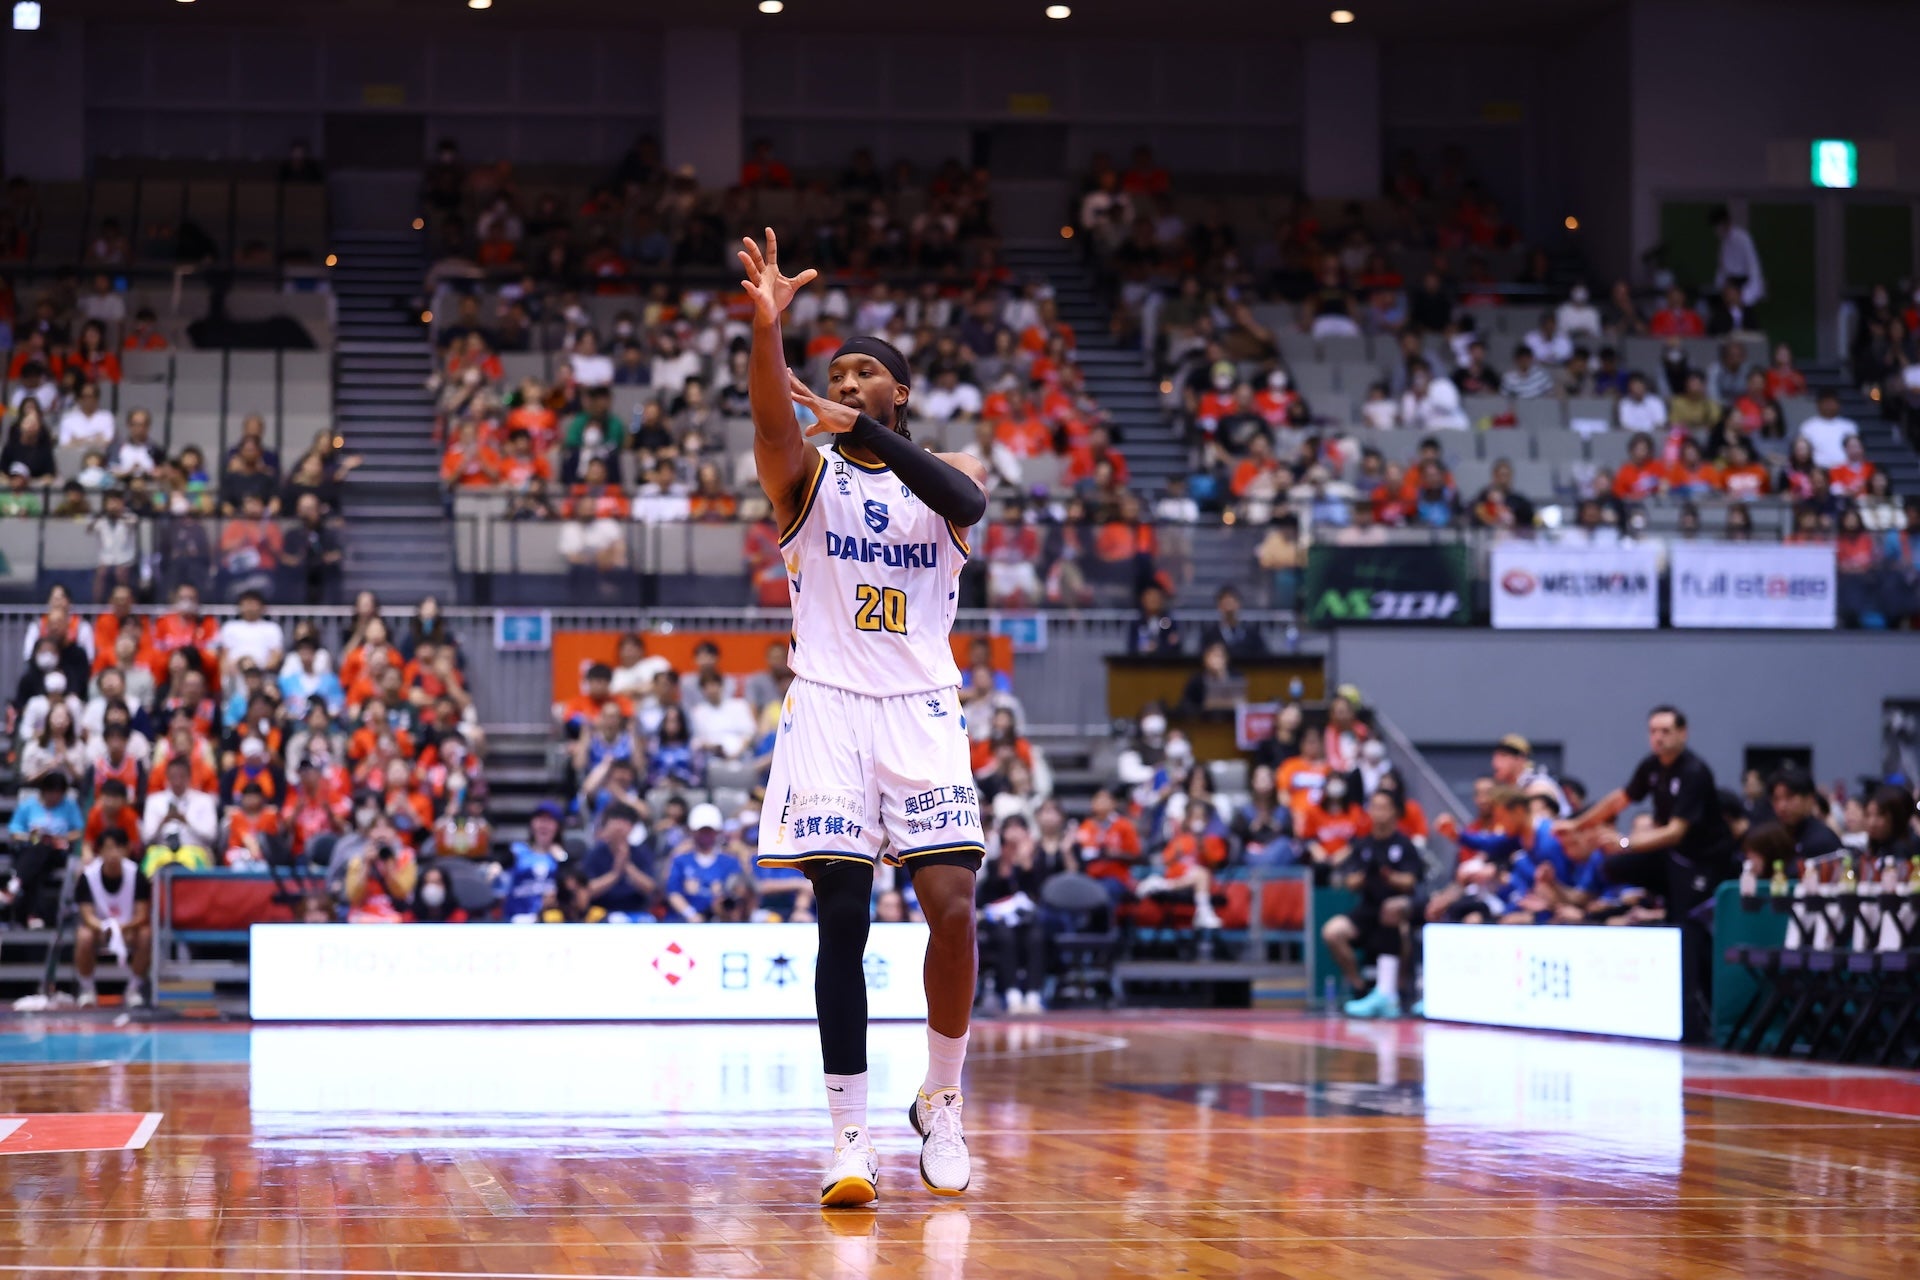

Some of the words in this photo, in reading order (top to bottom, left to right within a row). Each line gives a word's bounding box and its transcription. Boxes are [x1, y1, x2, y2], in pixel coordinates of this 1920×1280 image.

[826, 531, 937, 568] DAIFUKU
[855, 584, 907, 635] 20
[904, 785, 976, 816] 奥田工務店
[794, 815, 863, 839] 滋賀銀行
